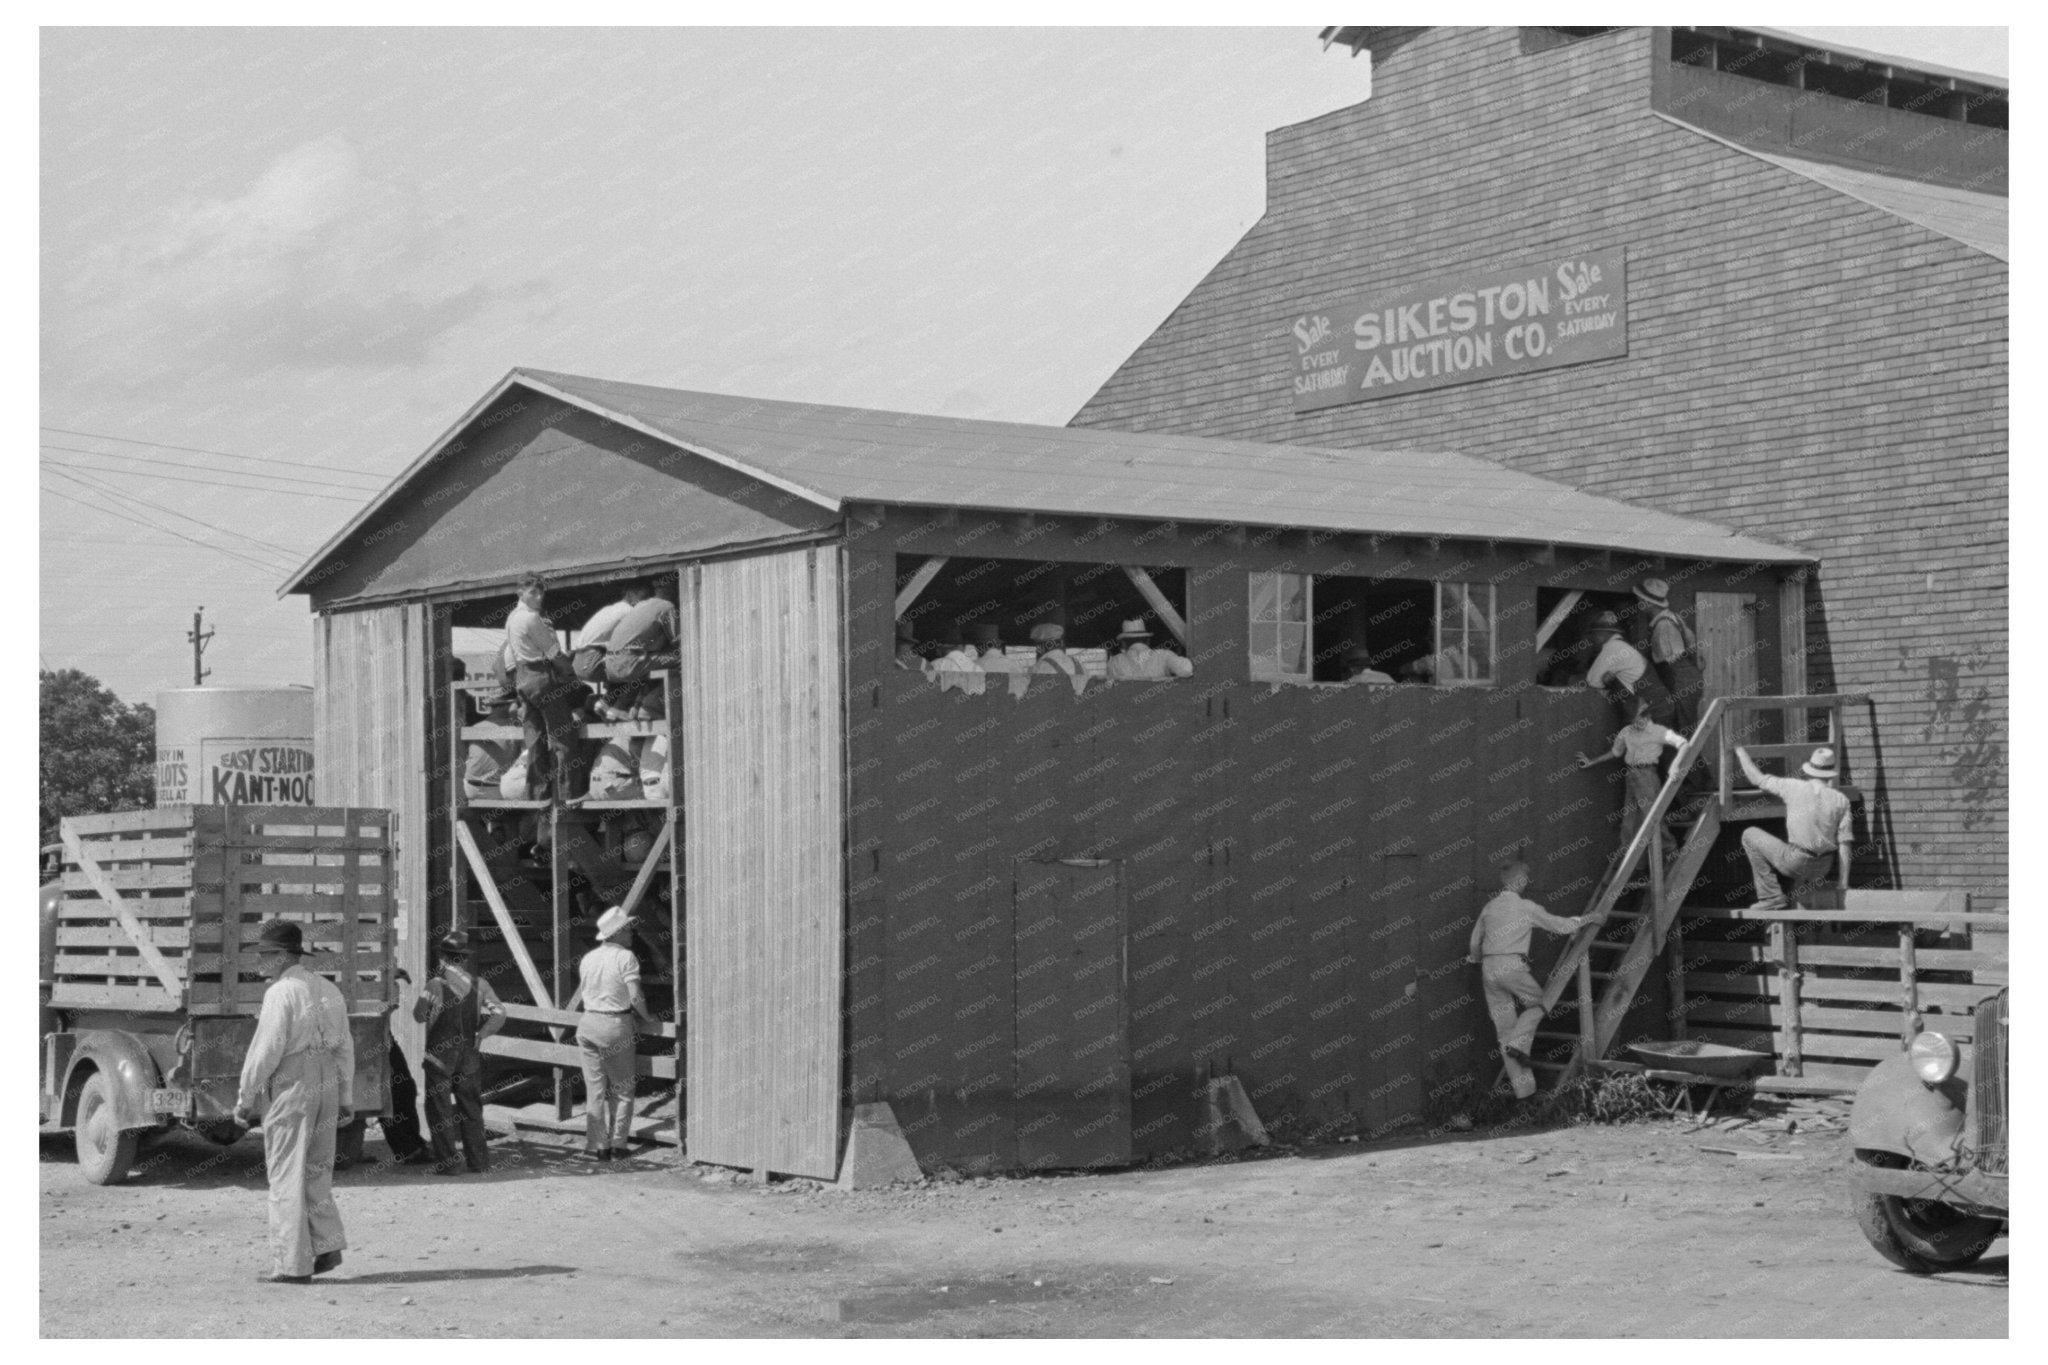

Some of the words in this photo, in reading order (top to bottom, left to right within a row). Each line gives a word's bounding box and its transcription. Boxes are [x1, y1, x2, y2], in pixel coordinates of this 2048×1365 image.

[1556, 261, 1602, 300] Sale
[1353, 277, 1550, 350] SIKESTON
[1565, 293, 1610, 315] EVERY
[1293, 315, 1331, 354] Sale
[1557, 311, 1617, 337] SATURDAY
[1301, 349, 1340, 371] EVERY
[1360, 331, 1493, 390] AUCTION
[1504, 322, 1553, 360] CO.
[1294, 364, 1350, 395] SATURDAY
[220, 748, 256, 771] EASY
[176, 788, 188, 801] AT
